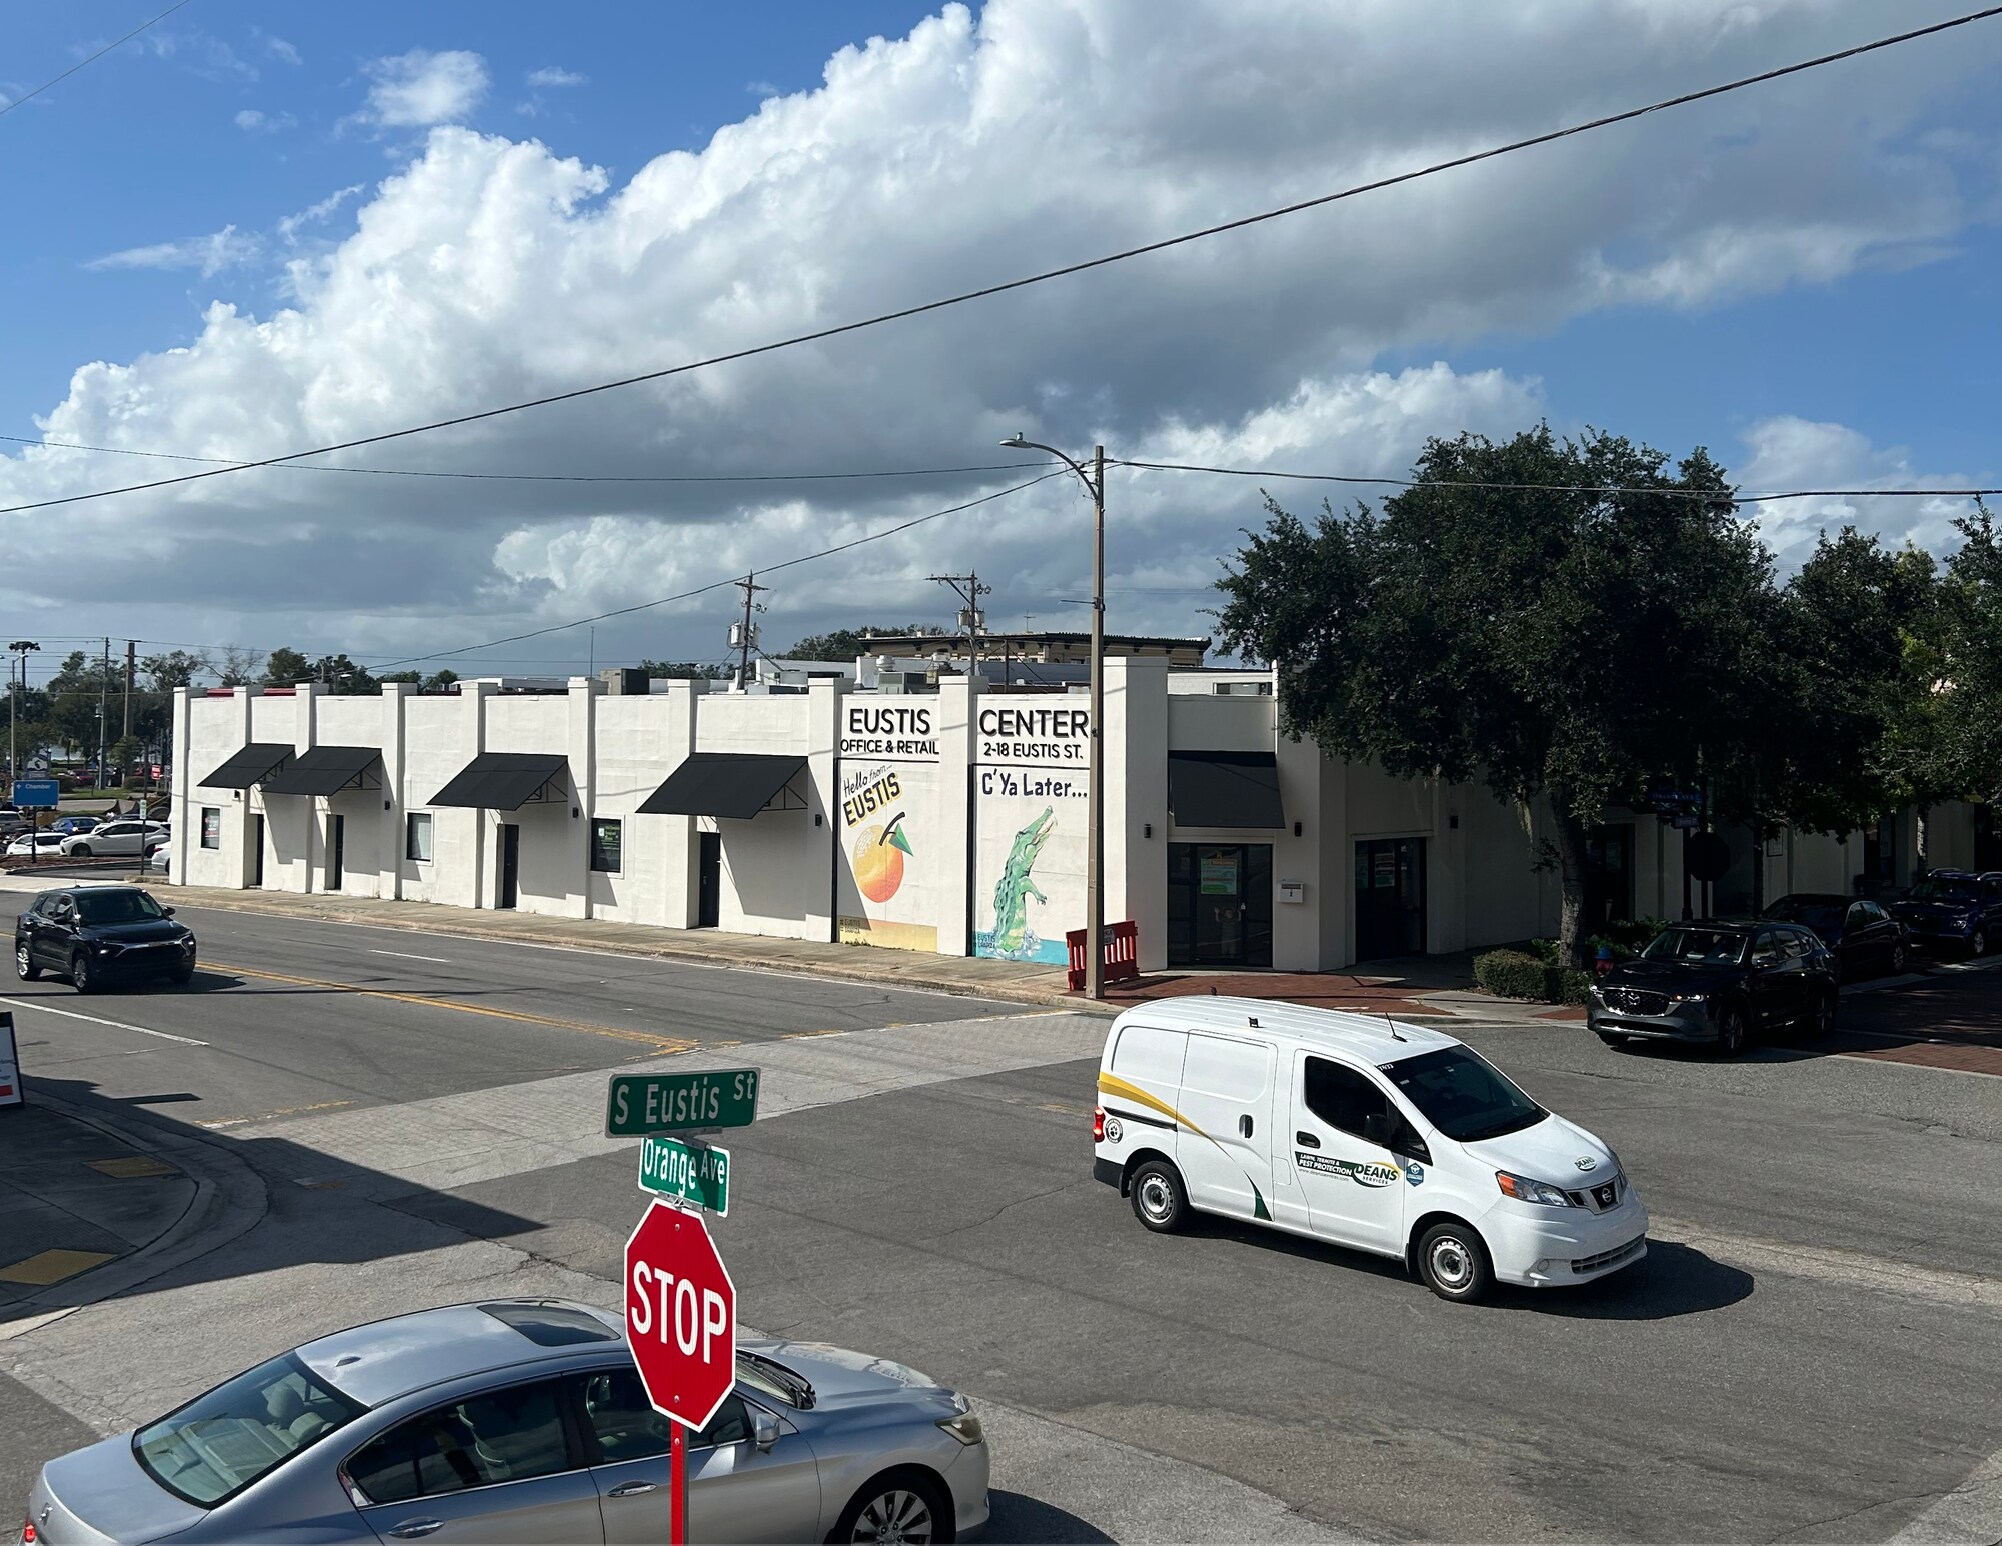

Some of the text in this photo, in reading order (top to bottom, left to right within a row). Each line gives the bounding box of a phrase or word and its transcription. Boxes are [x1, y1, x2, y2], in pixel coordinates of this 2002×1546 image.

[849, 708, 931, 735] EUSTIS
[979, 709, 1089, 739] CENTER
[840, 739, 940, 755] OFFICE & RETAIL
[983, 742, 1084, 759] 2-18 EUSTIS ST.
[843, 771, 868, 798] Hello
[842, 772, 902, 828] EUSTIS
[614, 1073, 754, 1125] S Eustis St
[644, 1137, 725, 1198] Orange Ave
[1313, 1161, 1353, 1176] PROTECTION
[1355, 1164, 1399, 1181] DEANS
[1362, 1175, 1389, 1185] SERVICES
[631, 1260, 727, 1364] STOP
